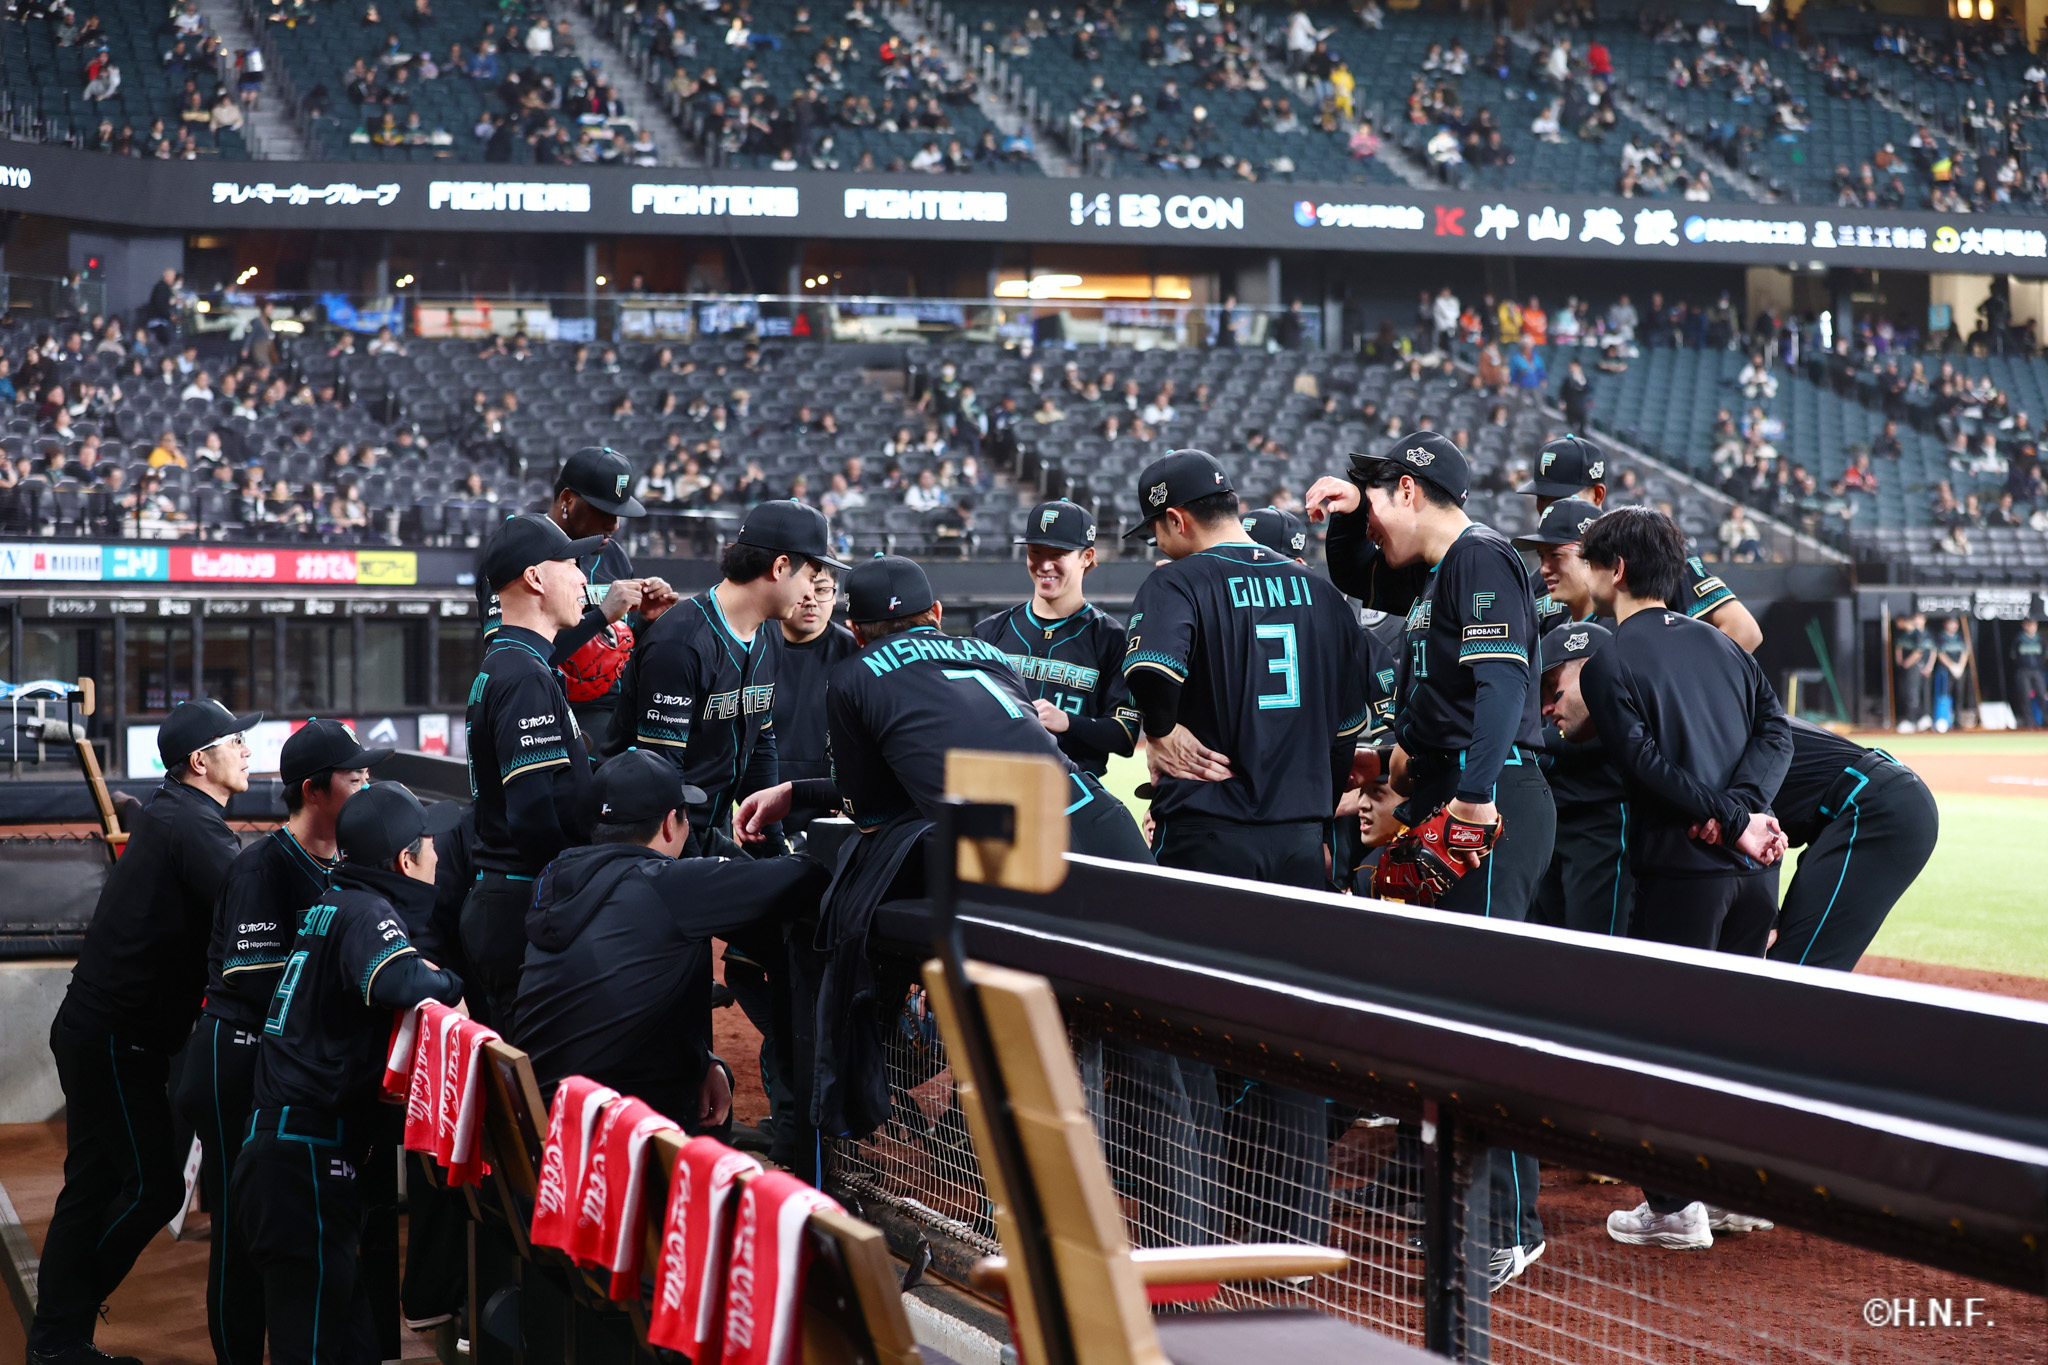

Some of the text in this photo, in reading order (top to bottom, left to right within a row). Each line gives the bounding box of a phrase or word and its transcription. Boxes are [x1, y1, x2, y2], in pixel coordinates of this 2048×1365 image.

[430, 181, 590, 212] FIGHTERS
[632, 184, 798, 217] FIGHTERS
[845, 188, 1007, 222] FIGHTERS
[615, 474, 630, 498] F
[1040, 509, 1060, 533] F
[113, 548, 158, 577] ニトリ
[1228, 575, 1313, 608] GUNJI
[1473, 592, 1496, 621] F
[1467, 628, 1501, 636] NEOBANK
[1256, 623, 1301, 710] 3
[941, 668, 1025, 720] 7
[1376, 668, 1395, 695] F
[663, 695, 692, 706] ホクレン
[247, 922, 277, 933] ホクレン
